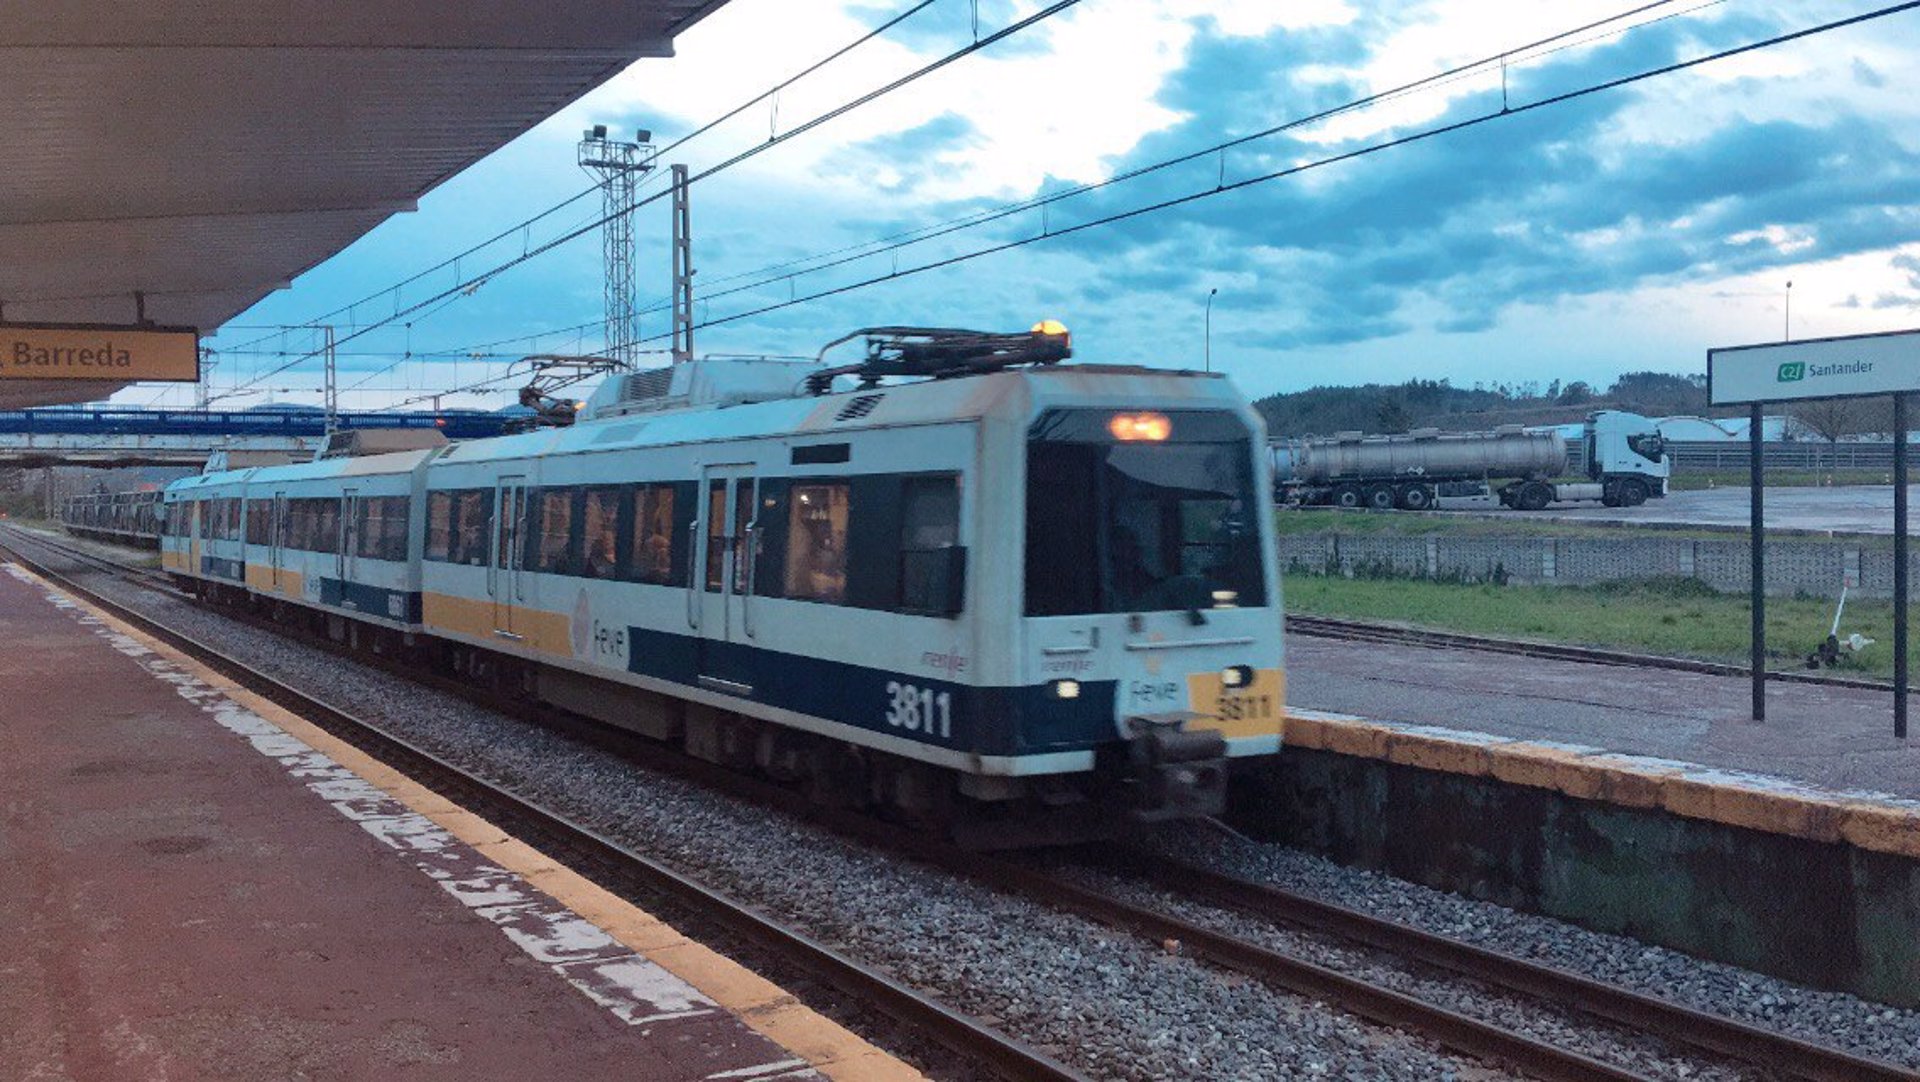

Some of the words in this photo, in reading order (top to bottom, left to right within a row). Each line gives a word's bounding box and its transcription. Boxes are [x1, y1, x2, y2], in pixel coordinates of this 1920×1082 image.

[13, 341, 131, 367] Barreda
[1809, 361, 1873, 377] Santander
[886, 681, 950, 738] 3811
[1218, 695, 1271, 720] 3811
